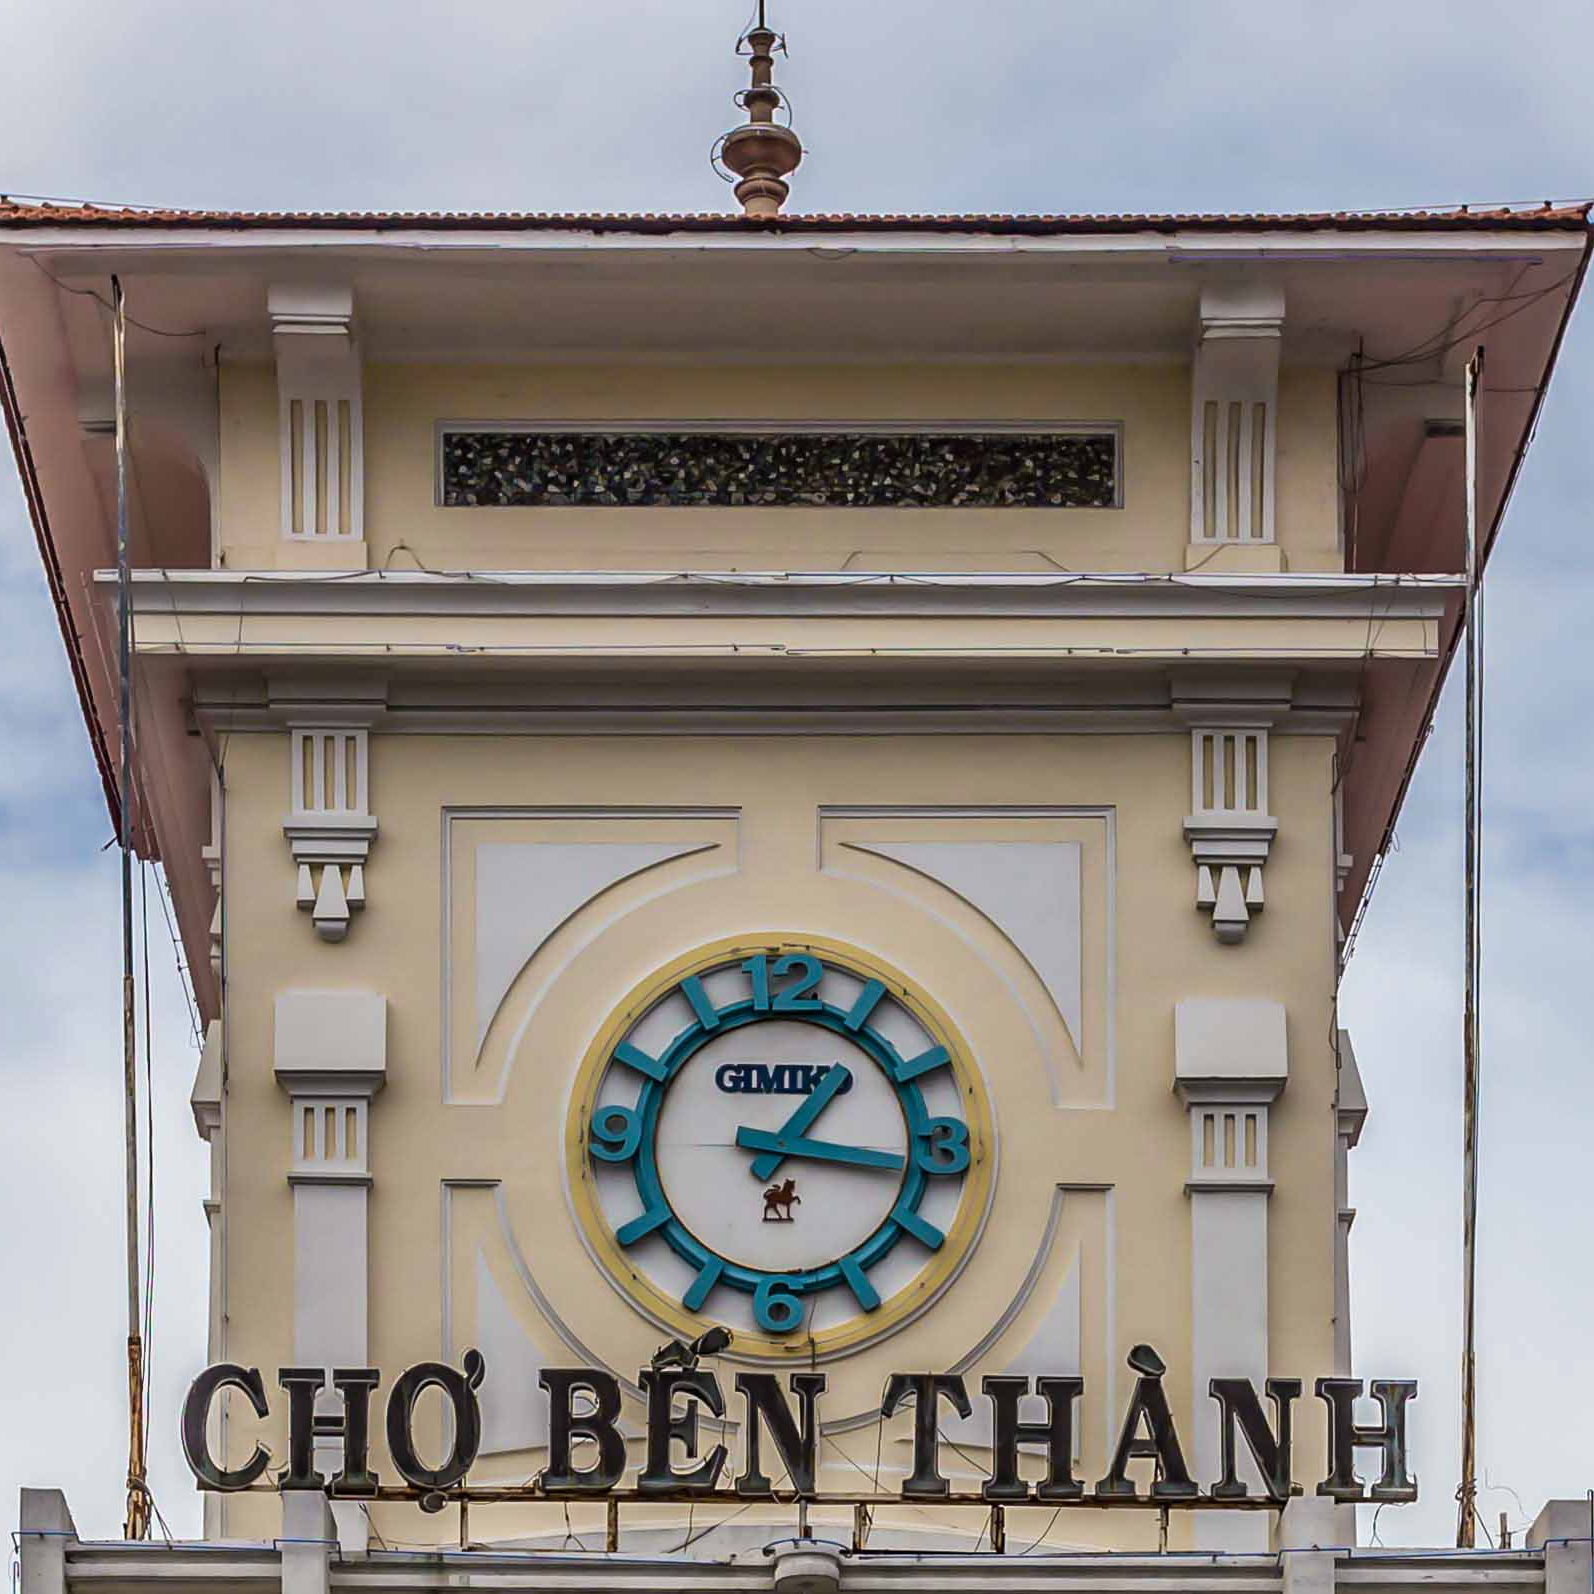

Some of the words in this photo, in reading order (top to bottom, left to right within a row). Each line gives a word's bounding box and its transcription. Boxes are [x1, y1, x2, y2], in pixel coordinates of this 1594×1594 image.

[742, 954, 823, 1010] 12
[589, 1105, 642, 1163] 9
[918, 1117, 971, 1174] 3
[754, 1275, 805, 1332] 6
[181, 1348, 486, 1514] CHỢ
[539, 1327, 830, 1497] BẾN
[880, 1344, 1419, 1499] THÀNH
